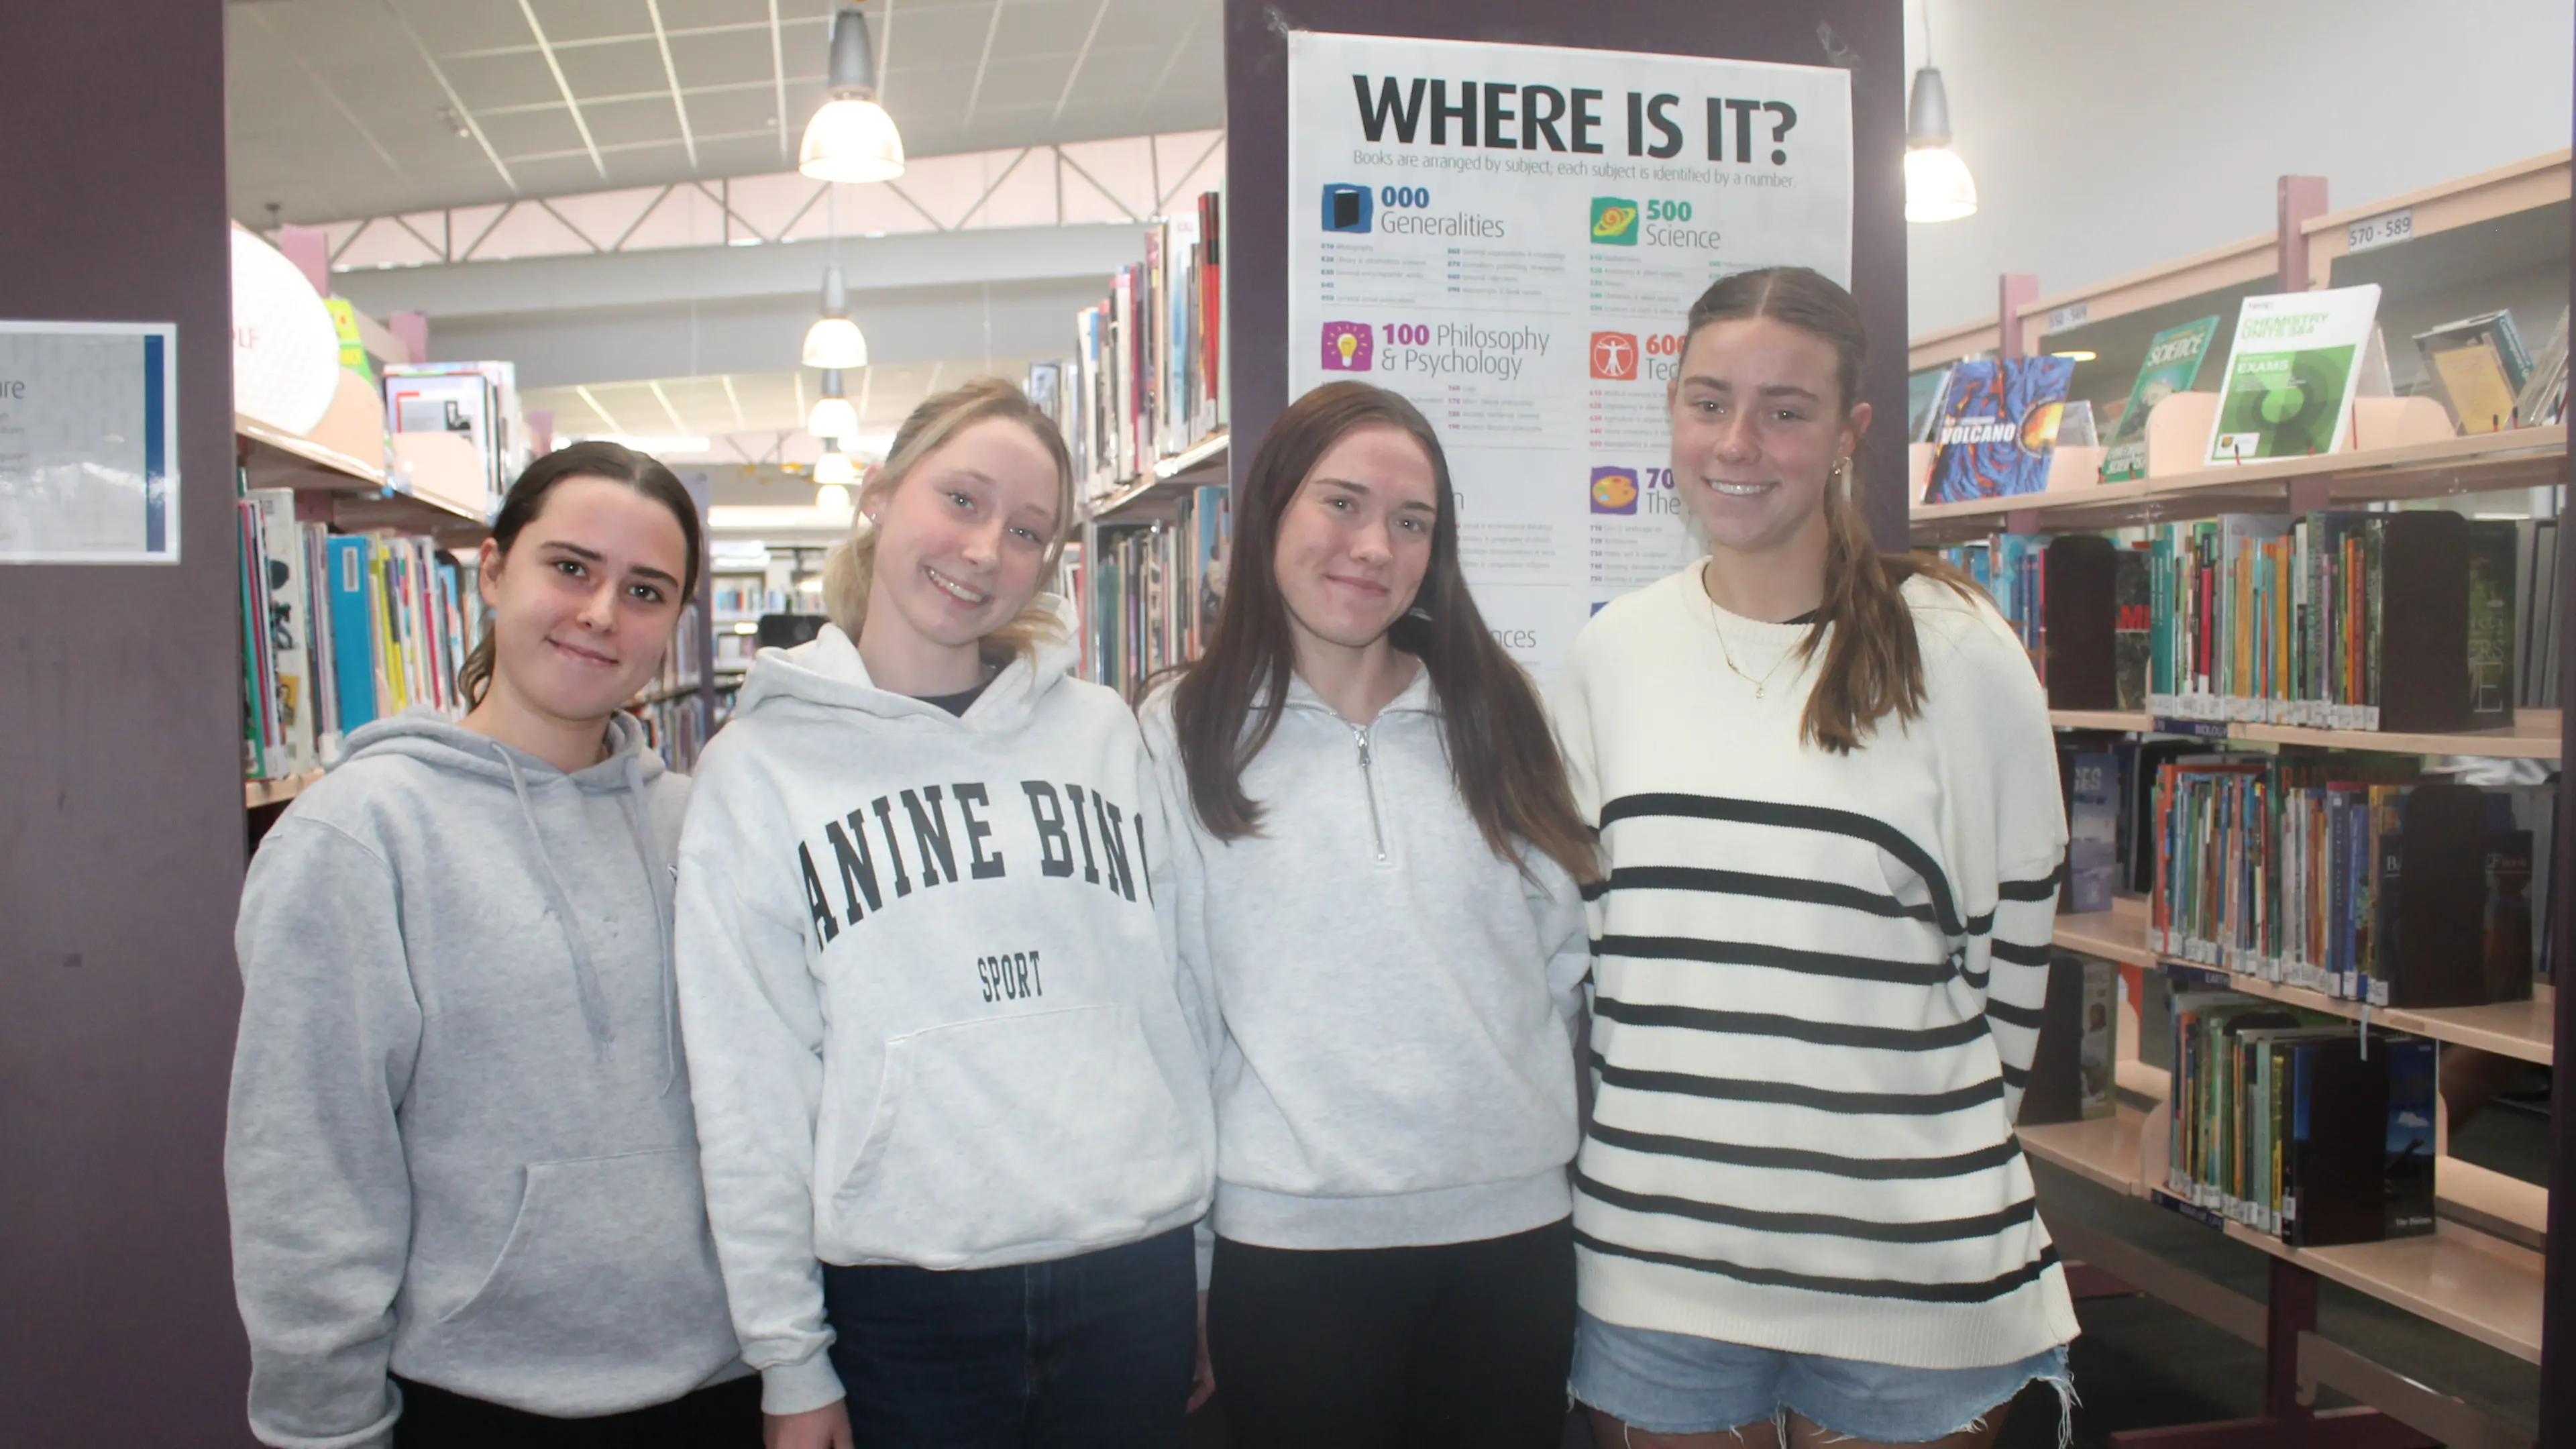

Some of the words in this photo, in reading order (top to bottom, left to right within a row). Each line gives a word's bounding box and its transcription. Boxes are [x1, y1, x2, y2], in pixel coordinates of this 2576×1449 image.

[1352, 74, 1603, 154] WHERE
[1627, 92, 1683, 159] IS
[1707, 97, 1796, 166] IT?
[1353, 149, 1393, 166] Books
[1398, 154, 1418, 168] are
[1423, 154, 1481, 174] arranged
[1486, 155, 1505, 176] by
[1558, 161, 1588, 176] each
[1593, 164, 1635, 180] subject
[1640, 166, 1649, 180] is
[1654, 166, 1710, 184] identified
[1715, 168, 1730, 187] by
[1733, 173, 1741, 185] a
[1381, 186, 1430, 208] 000
[1646, 199, 1692, 221] 500
[1381, 211, 1505, 238] Generalities
[1646, 223, 1721, 249] Science
[2350, 226, 2373, 246] 570
[2385, 217, 2411, 237] 589
[2241, 325, 2283, 340] UNITS
[2245, 313, 2329, 328] CHEMISTRY
[1382, 323, 1430, 345] 100
[1438, 324, 1550, 357] Philosophy
[1381, 348, 1397, 372] &
[1405, 349, 1523, 381] Psychology
[2238, 360, 2290, 374] EXAMS
[1941, 423, 2016, 445] VOLCANO
[1646, 490, 1681, 515] The
[799, 782, 1006, 952] ANINE
[1021, 780, 1155, 911] BIN
[978, 950, 1042, 1002] SPORT
